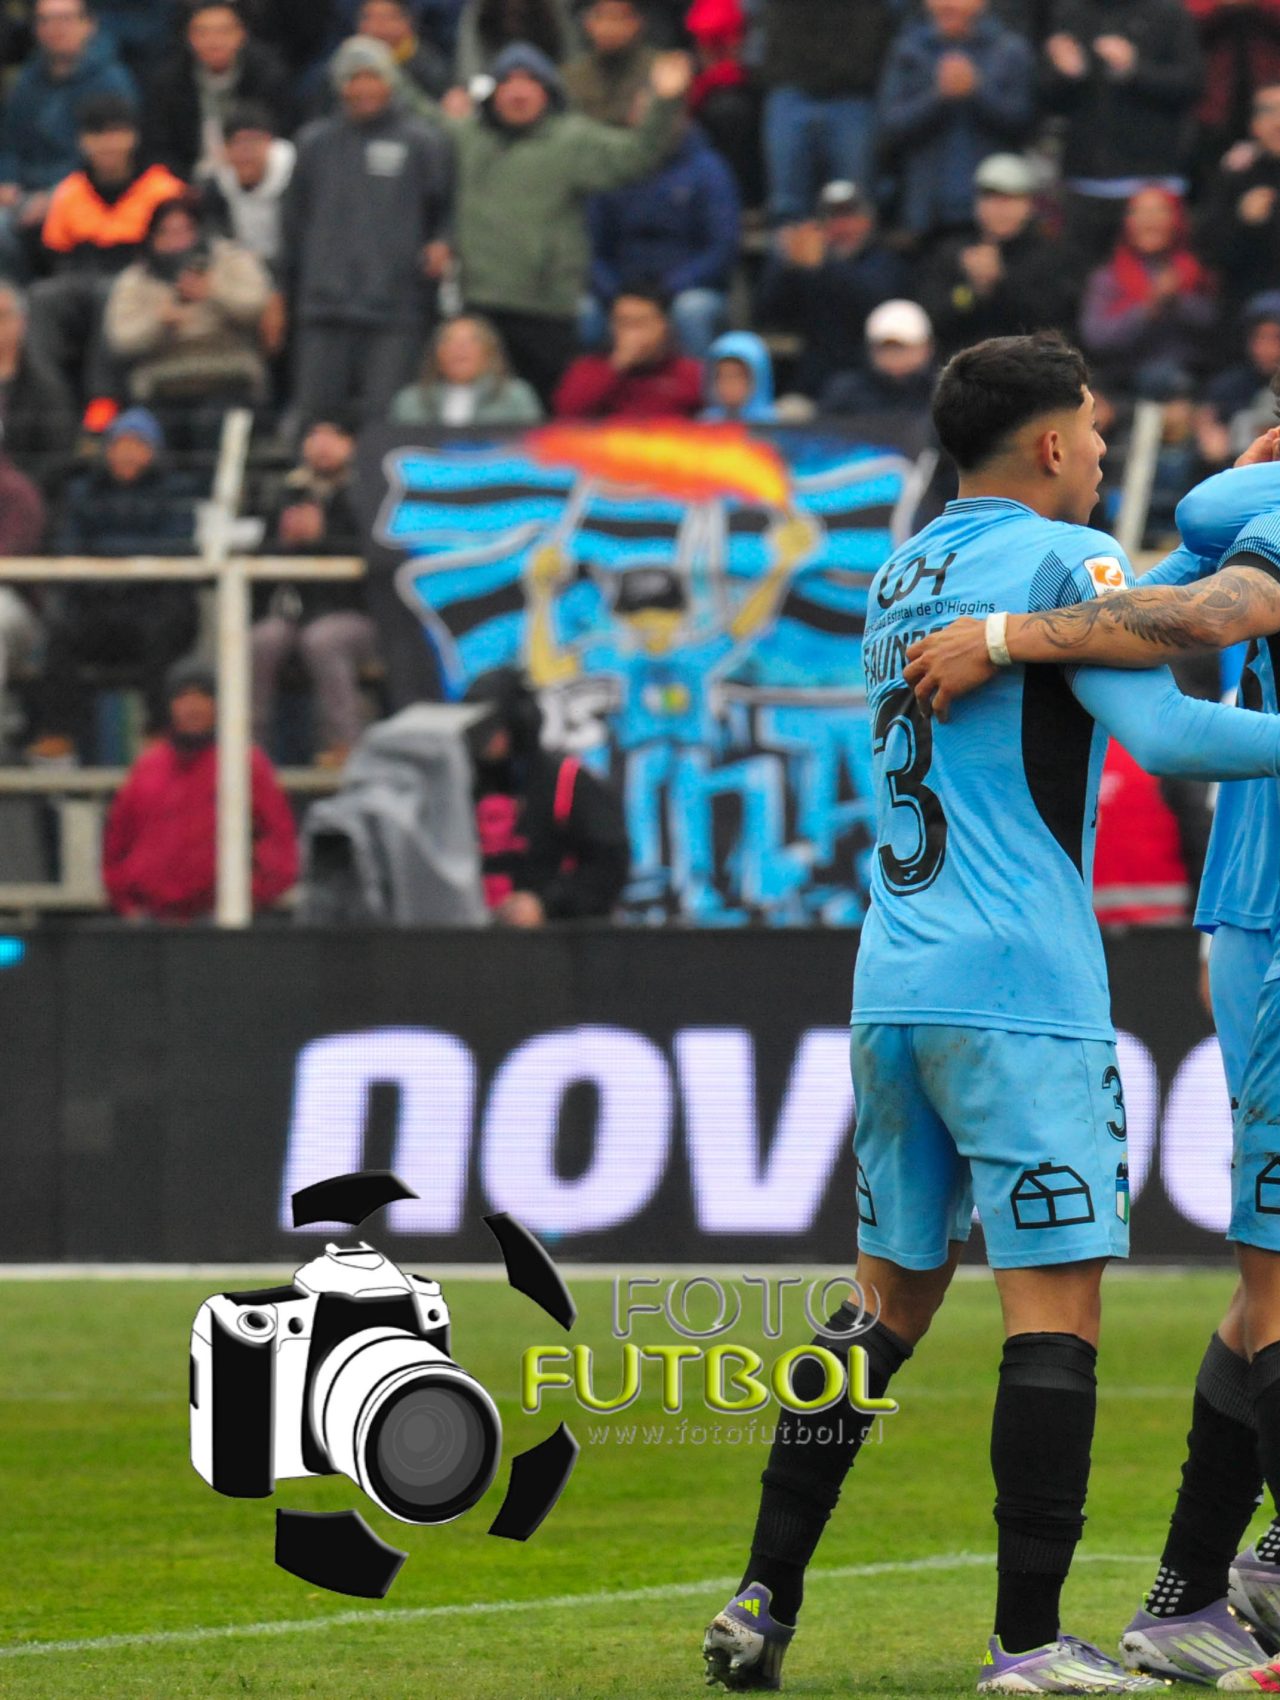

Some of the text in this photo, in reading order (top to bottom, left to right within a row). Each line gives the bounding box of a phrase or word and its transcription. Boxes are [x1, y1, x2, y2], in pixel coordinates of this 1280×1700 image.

[916, 602, 932, 617] de
[934, 600, 996, 616] O'Higgins
[873, 687, 949, 896] 3
[1102, 1066, 1128, 1142] 3
